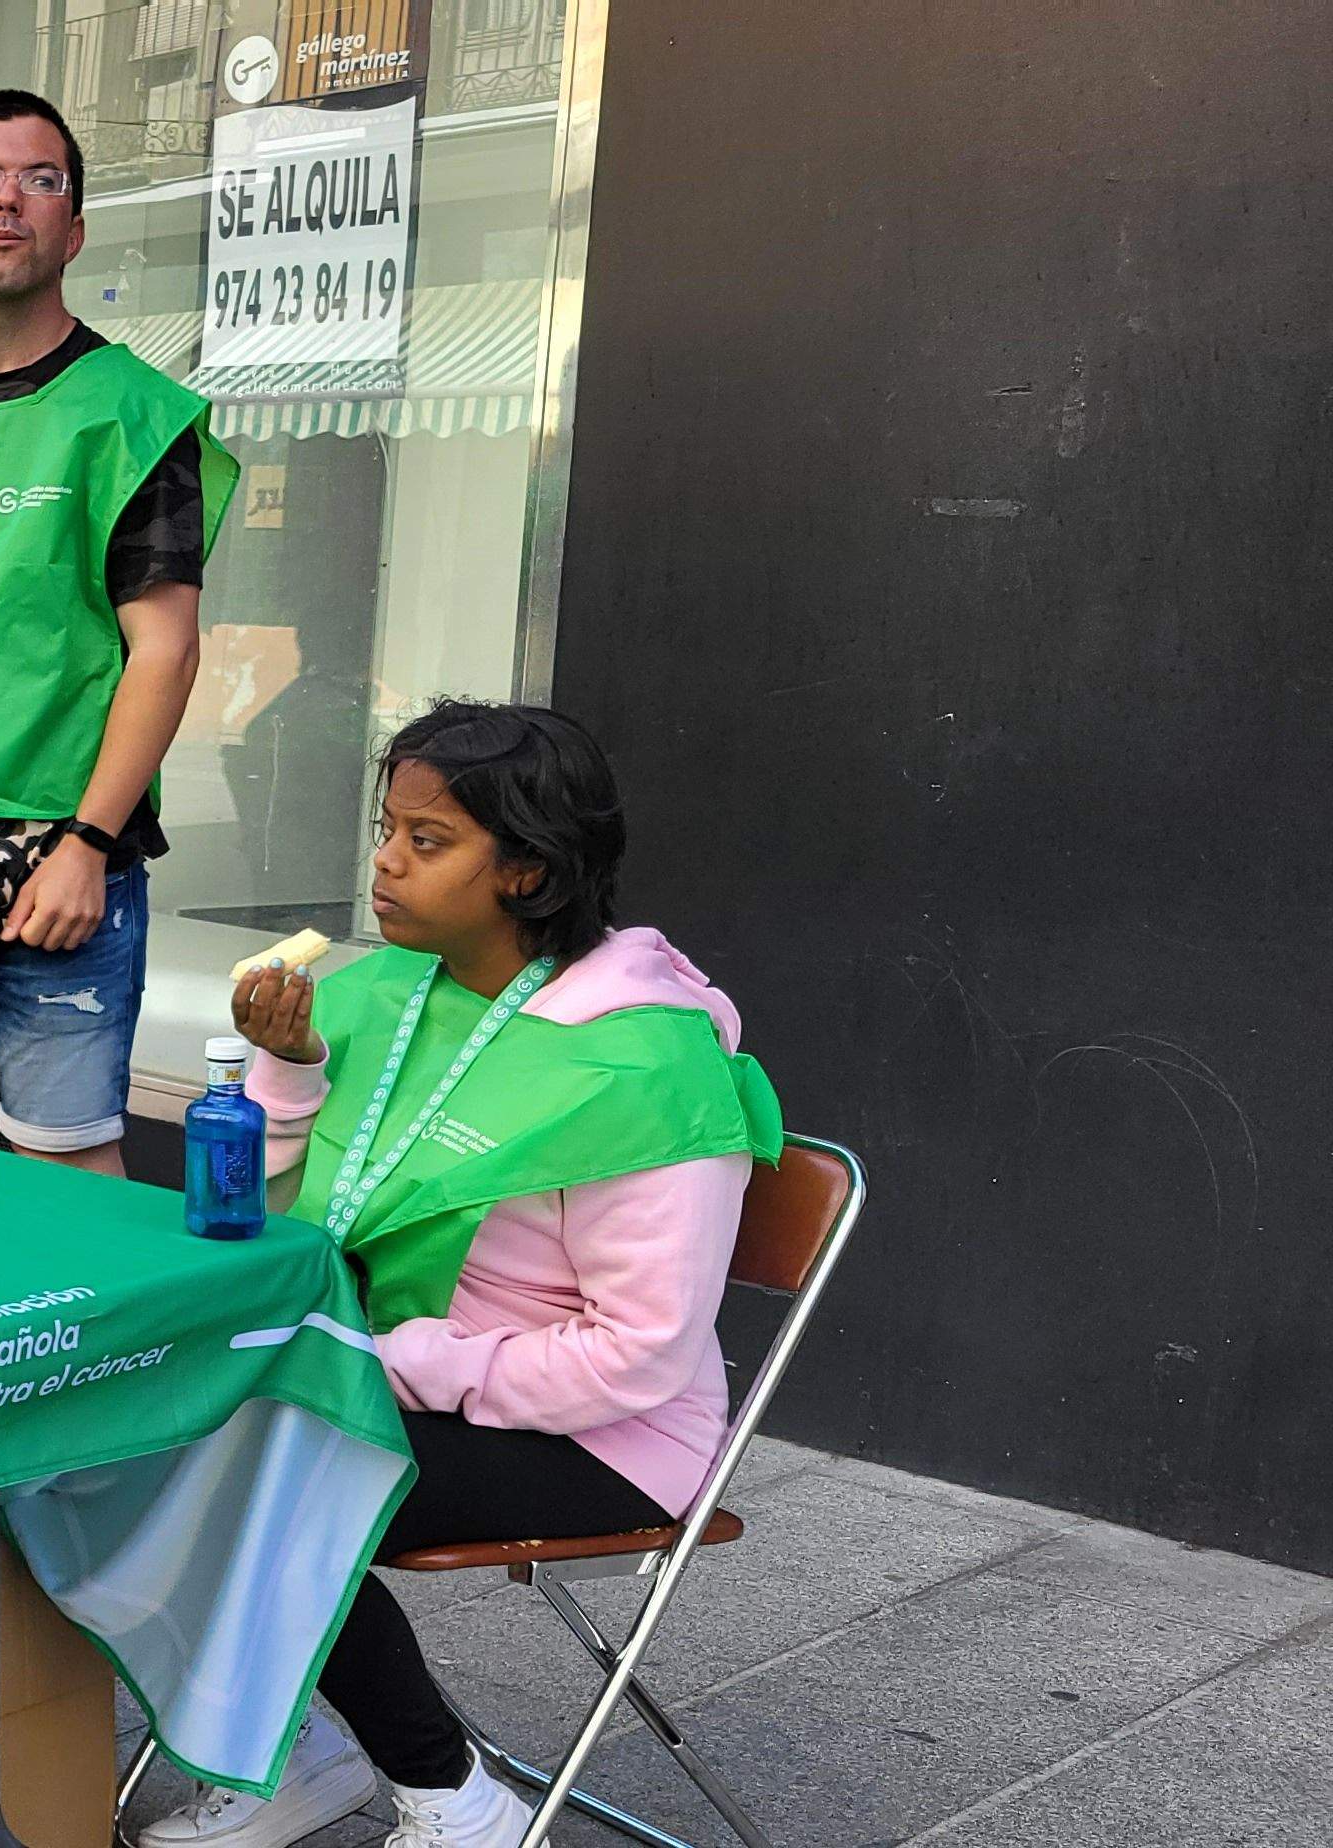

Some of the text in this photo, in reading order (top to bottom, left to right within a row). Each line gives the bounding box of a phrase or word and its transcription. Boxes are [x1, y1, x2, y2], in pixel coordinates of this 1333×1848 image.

[296, 33, 366, 63] gállego
[320, 49, 410, 76] martínez
[218, 153, 400, 240] SE ALQUILA
[215, 258, 396, 329] 974 23 84 19
[38, 1363, 70, 1398] el
[71, 1341, 175, 1387] cáncer
